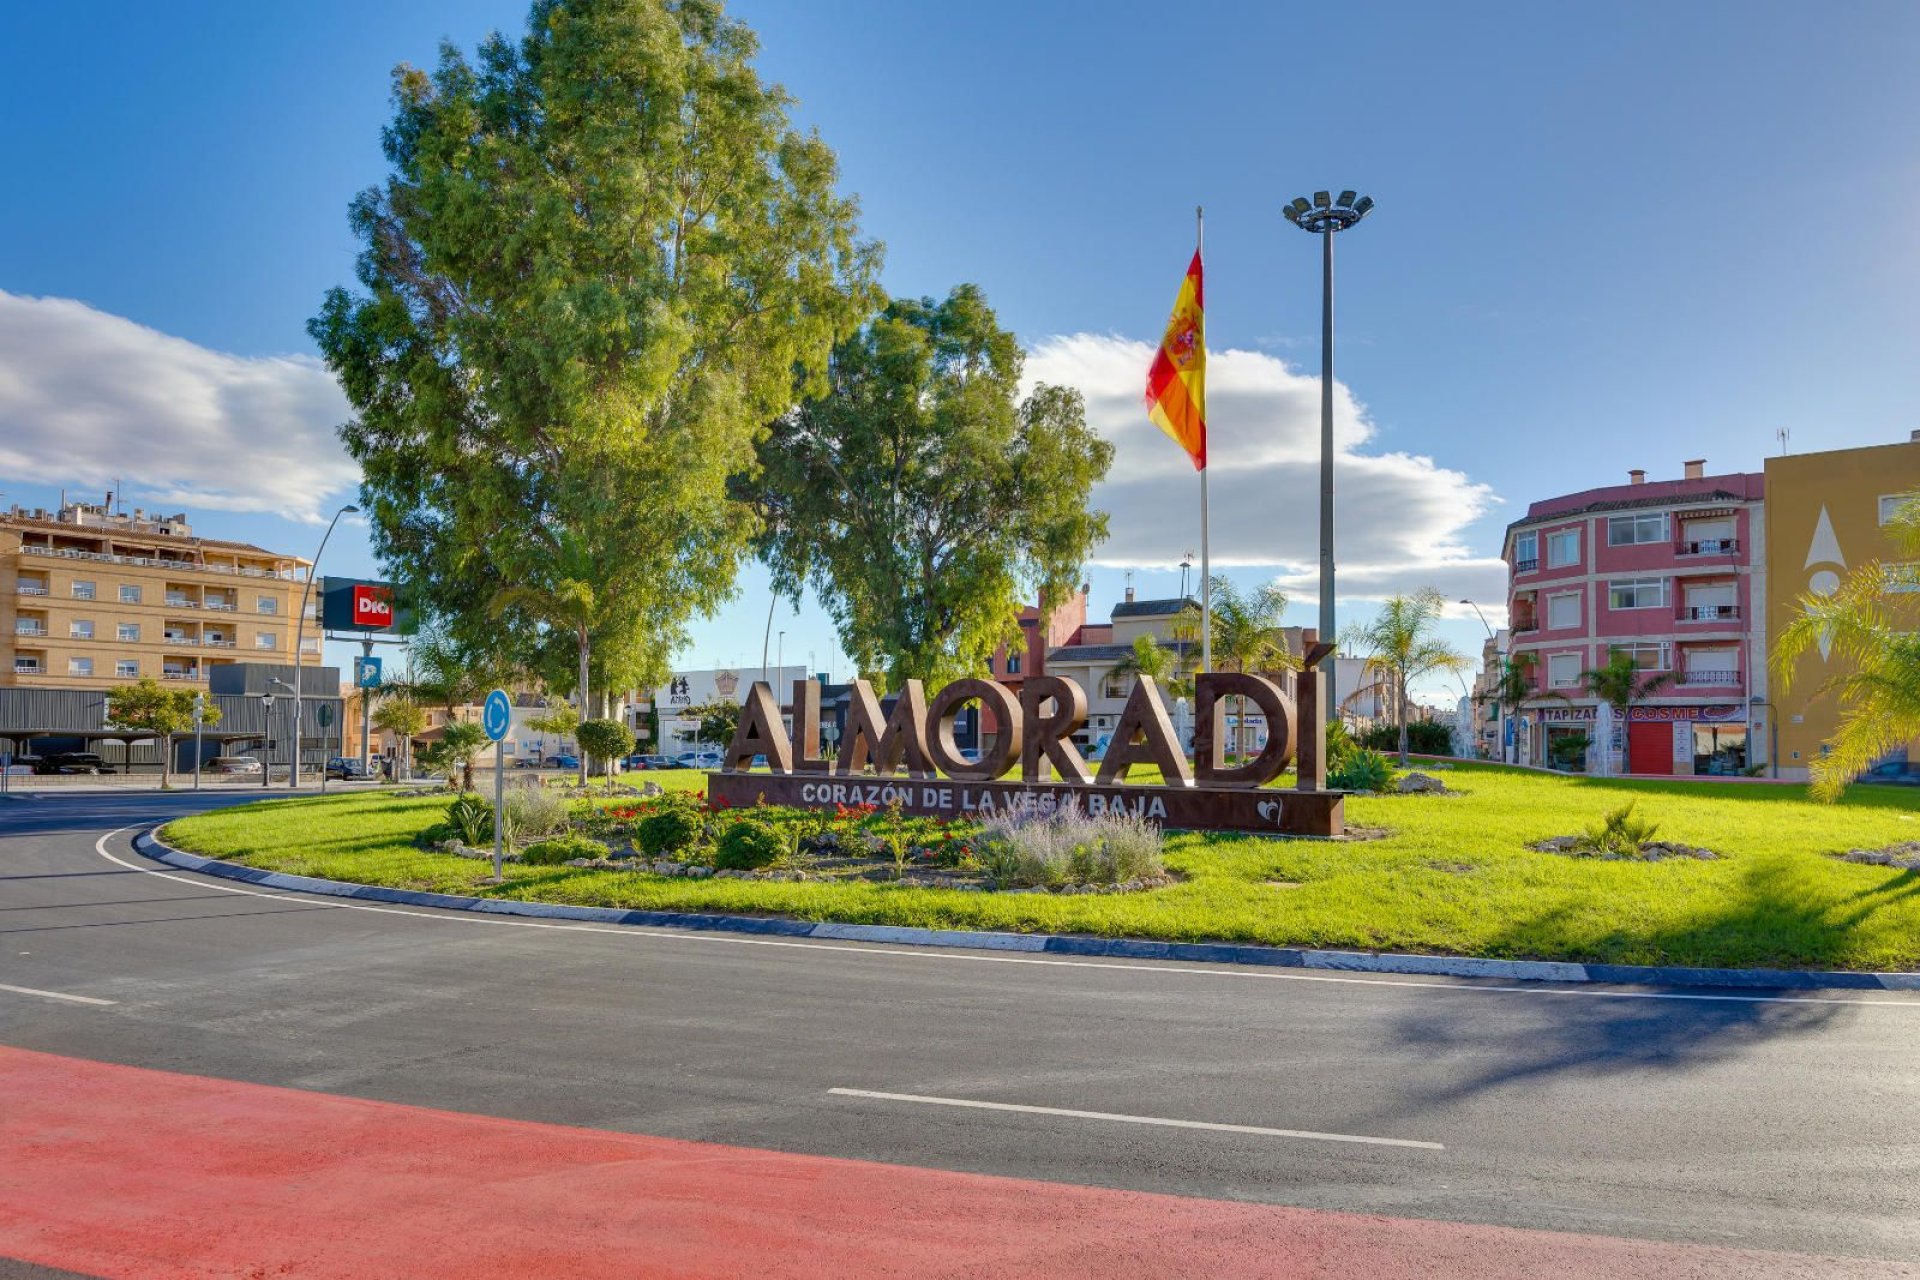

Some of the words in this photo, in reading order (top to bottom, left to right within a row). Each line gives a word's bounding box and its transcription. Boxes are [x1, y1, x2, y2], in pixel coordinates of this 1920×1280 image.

[722, 642, 1336, 792] ALMORADÍ
[1544, 707, 1623, 721] TAPIZAS
[1631, 706, 1700, 721] COSME
[802, 782, 913, 807] CORAZÓN
[922, 787, 953, 808] DE
[962, 789, 996, 812] LA
[1088, 793, 1168, 818] BAJA
